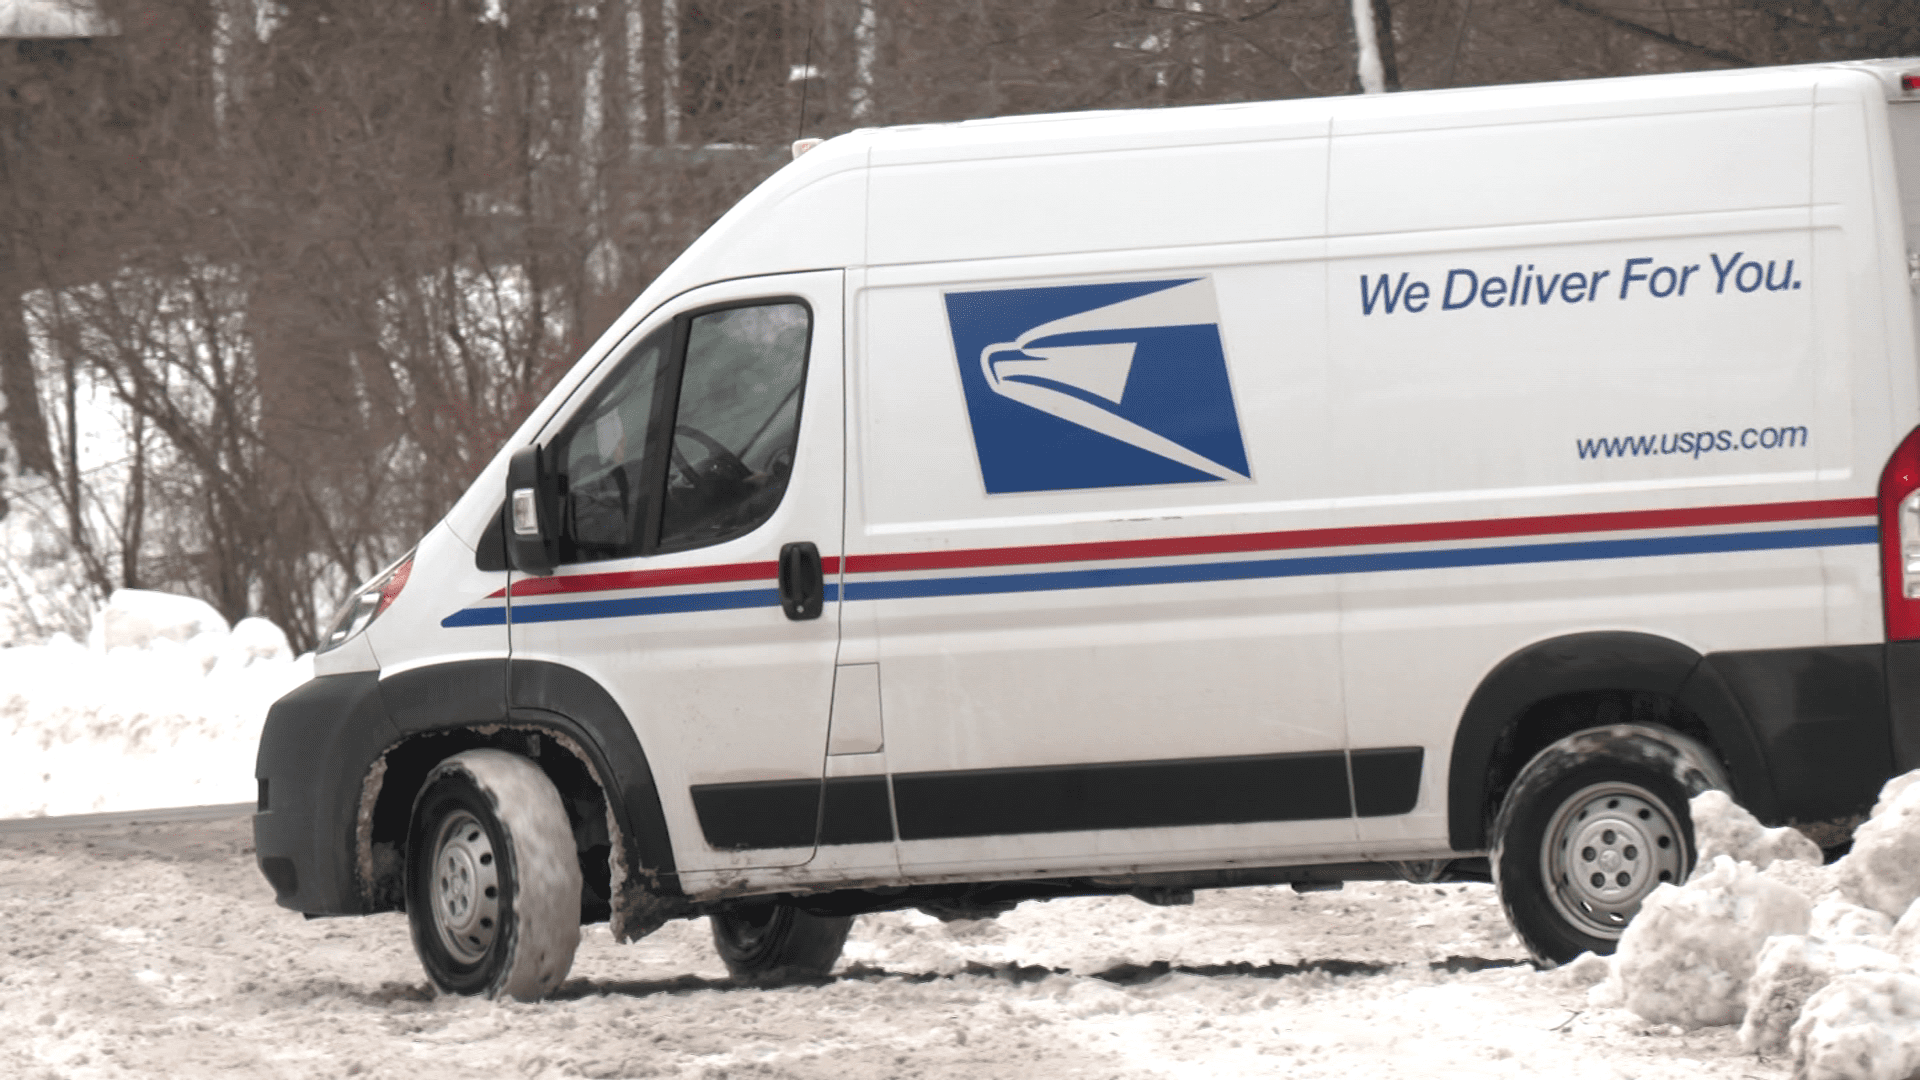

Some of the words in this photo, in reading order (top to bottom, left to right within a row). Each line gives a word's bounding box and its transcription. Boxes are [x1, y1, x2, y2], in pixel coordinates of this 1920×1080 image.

[1360, 272, 1430, 316] We
[1441, 264, 1610, 311] Deliver
[1620, 257, 1700, 300] For
[1711, 251, 1803, 294] You.
[1577, 425, 1808, 460] www.usps.com
